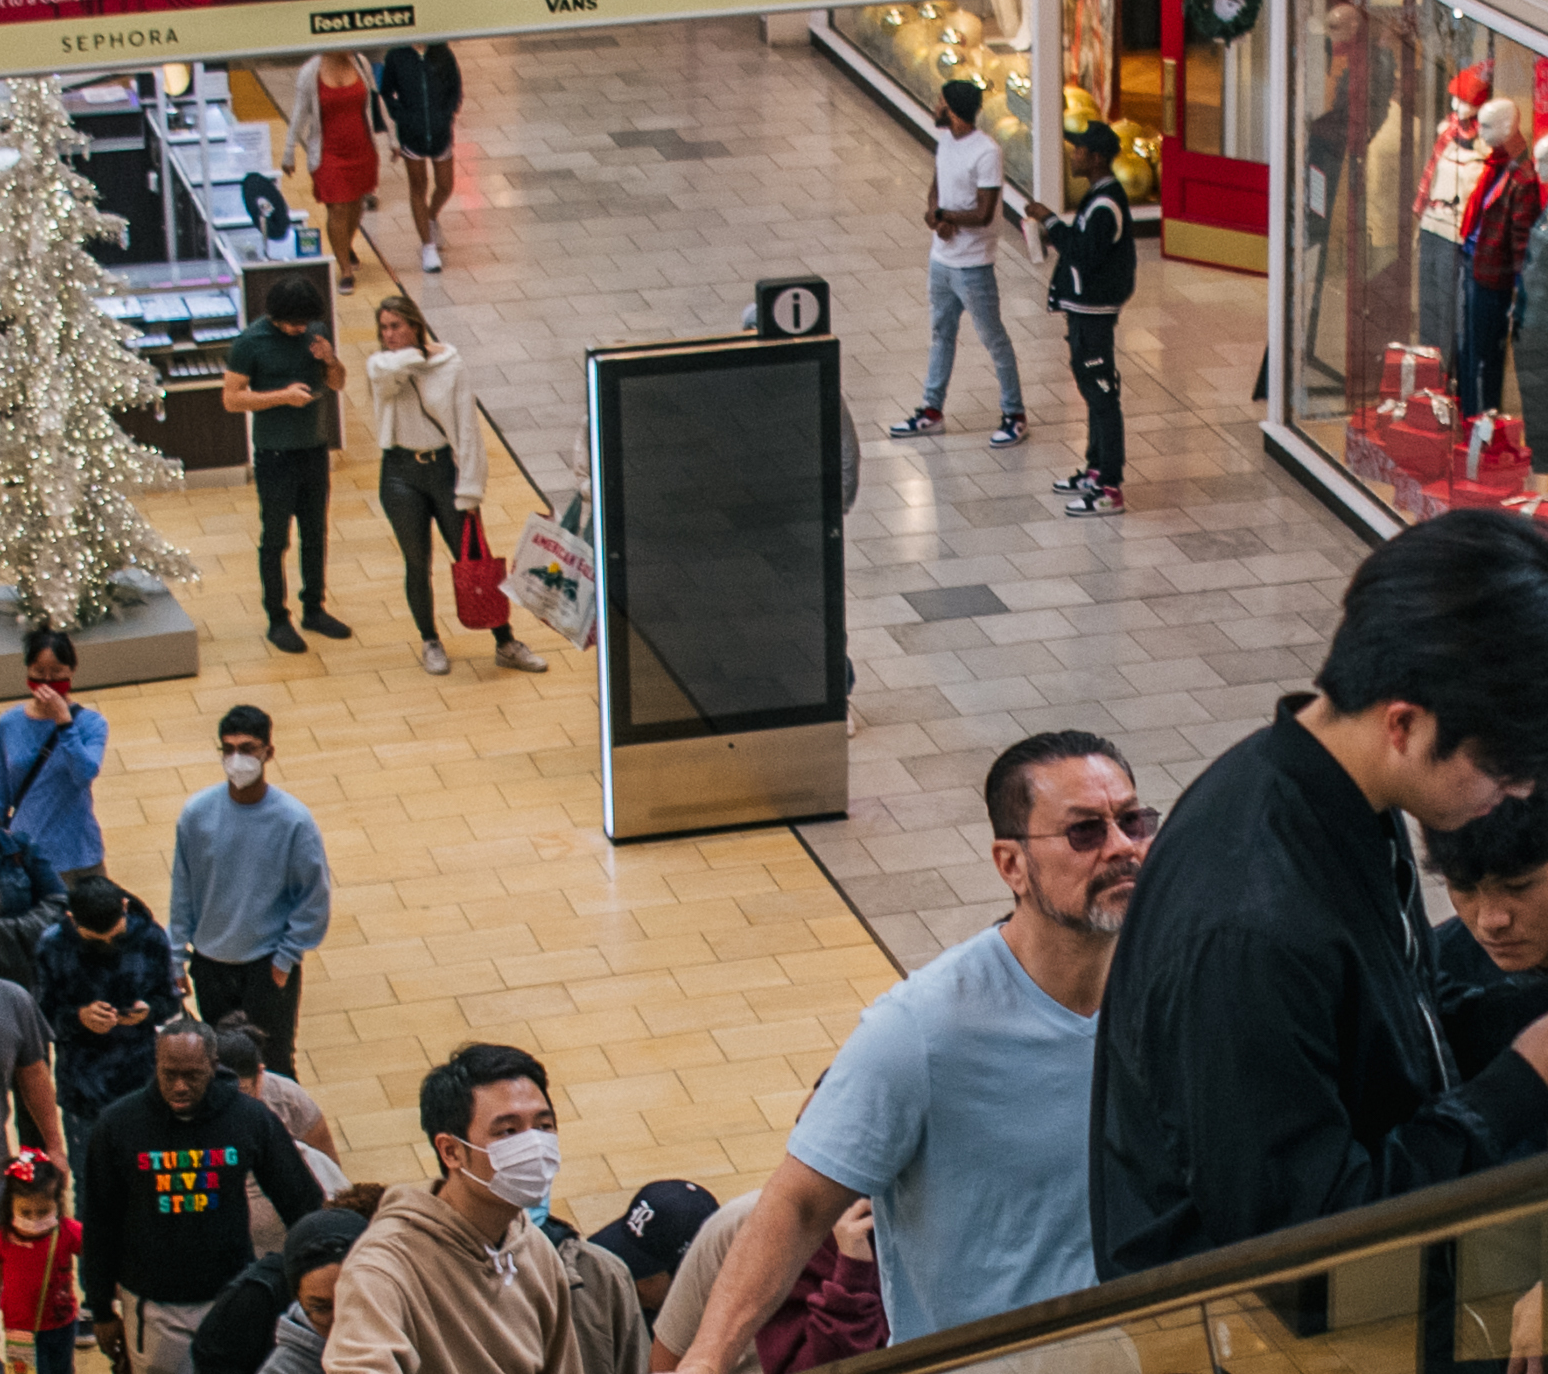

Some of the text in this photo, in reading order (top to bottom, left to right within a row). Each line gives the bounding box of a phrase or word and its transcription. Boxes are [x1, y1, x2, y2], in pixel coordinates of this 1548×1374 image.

[313, 8, 413, 32] Foot Locker
[61, 27, 180, 54] SEPHORA
[137, 1145, 239, 1171] STUDYING
[155, 1171, 220, 1193] NEVER
[158, 1192, 220, 1214] STOPS
